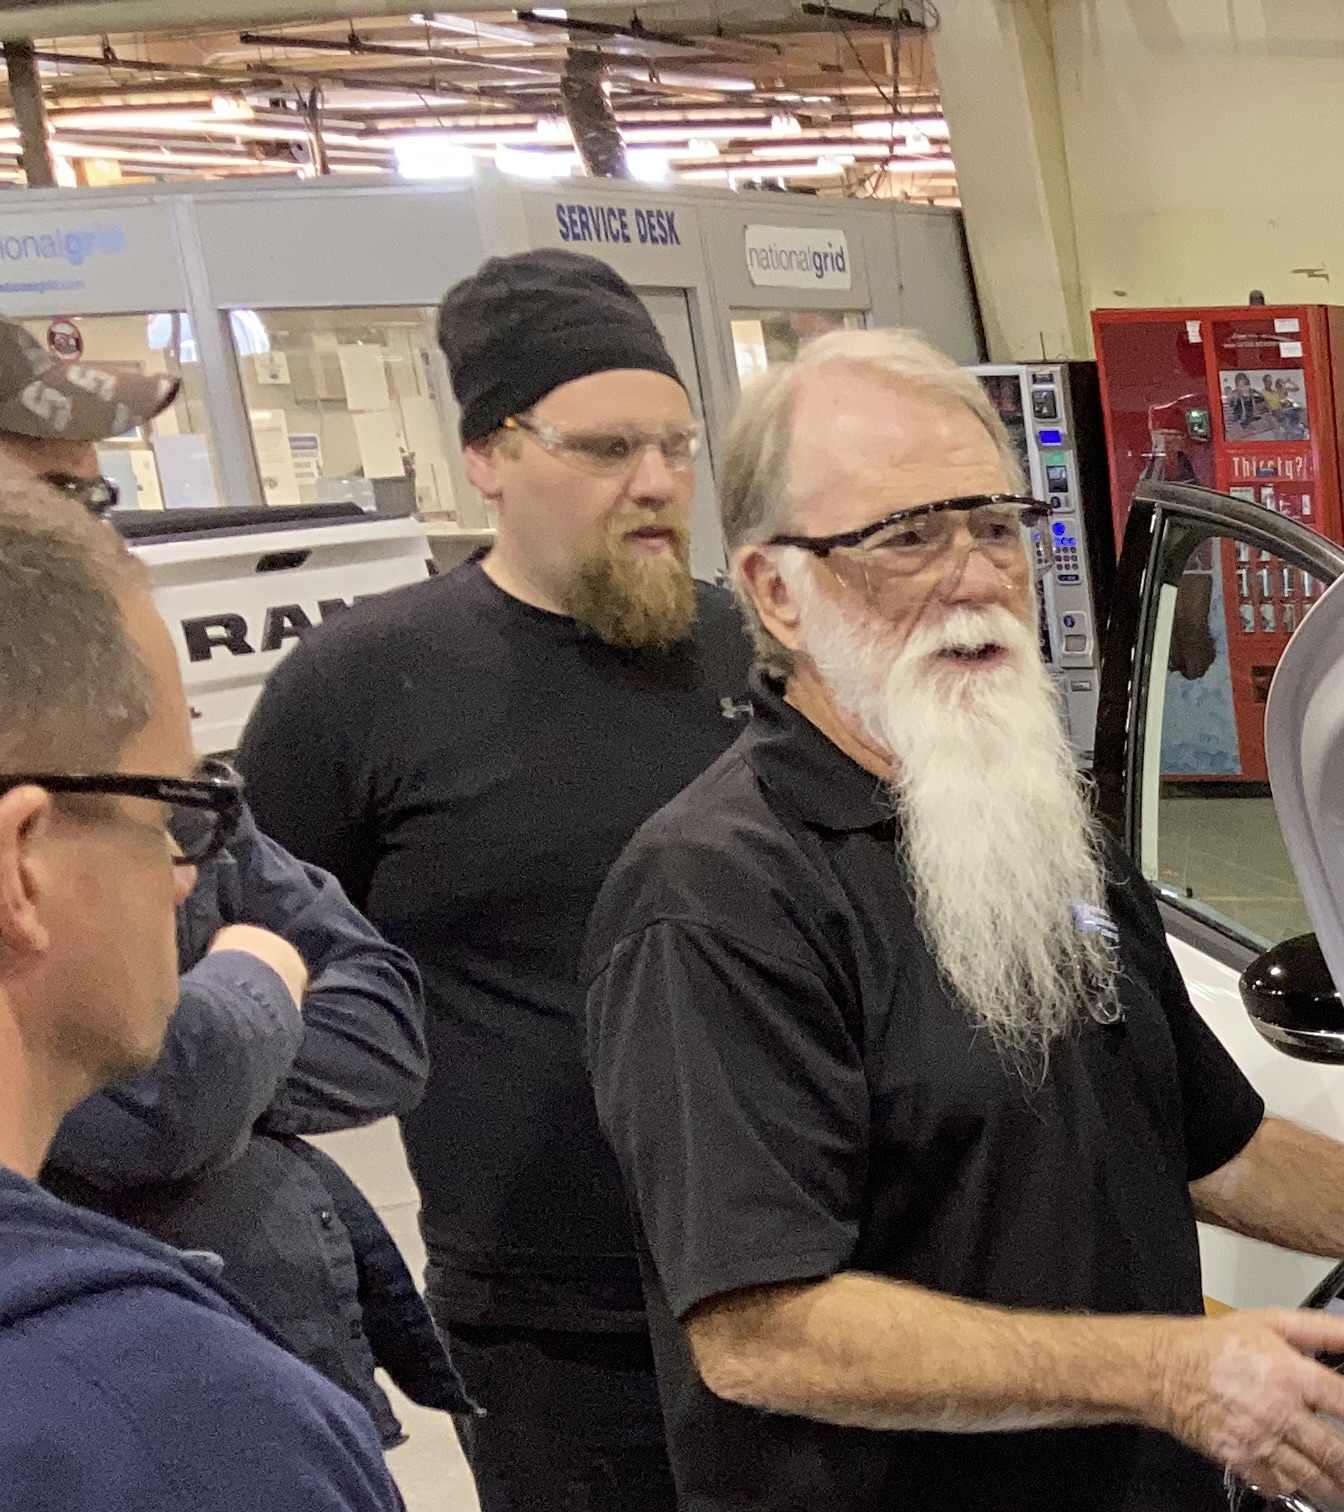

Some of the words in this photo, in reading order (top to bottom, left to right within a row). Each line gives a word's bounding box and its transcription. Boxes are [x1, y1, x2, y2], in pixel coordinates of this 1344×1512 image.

[556, 203, 632, 243] SERVICE
[634, 209, 681, 245] DESK
[749, 242, 846, 279] nationalgrid
[181, 597, 382, 663] RA
